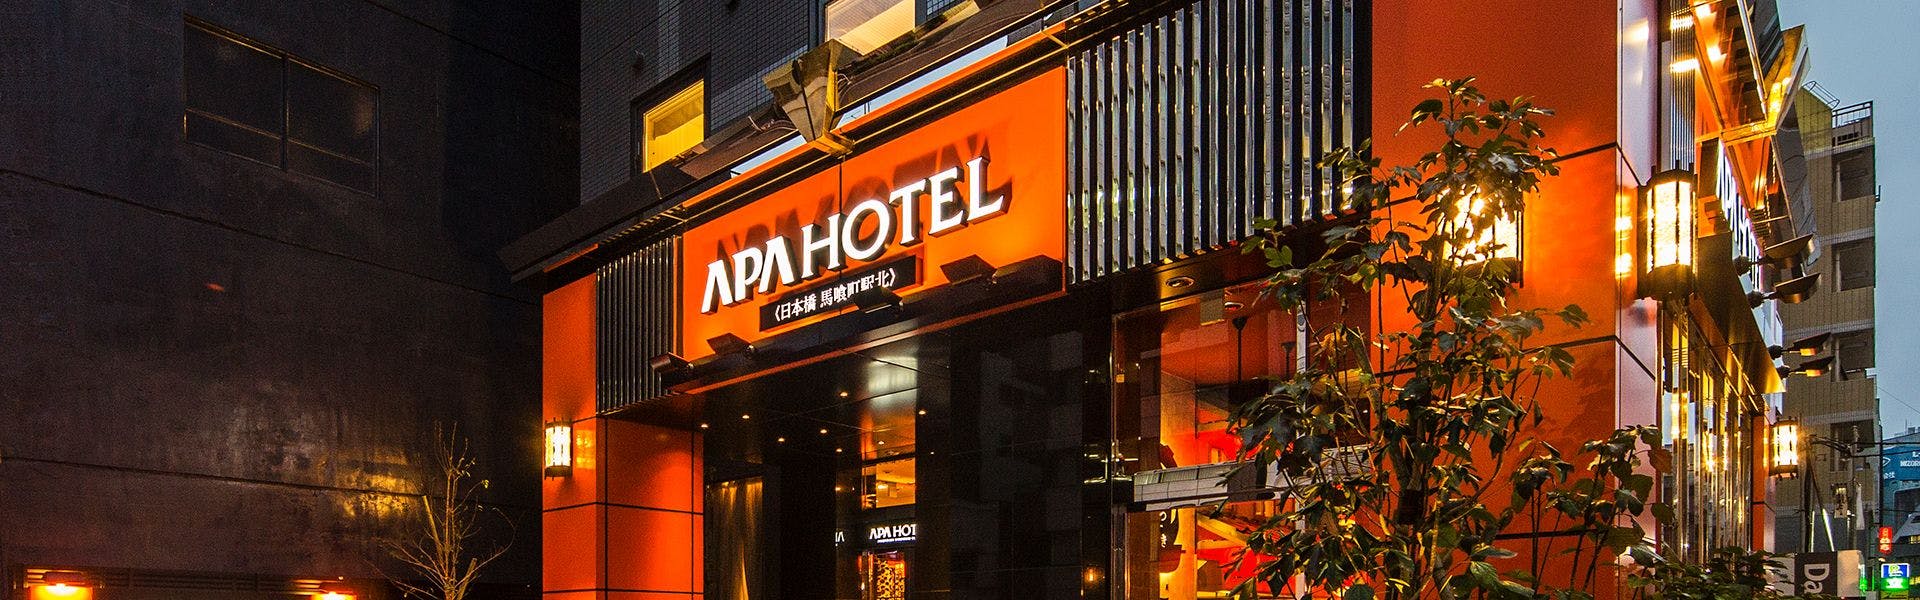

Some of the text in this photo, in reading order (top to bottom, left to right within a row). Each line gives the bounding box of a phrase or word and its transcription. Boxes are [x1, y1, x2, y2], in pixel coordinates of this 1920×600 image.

[701, 157, 1004, 313] APA HOTEL
[869, 527, 891, 539] APA
